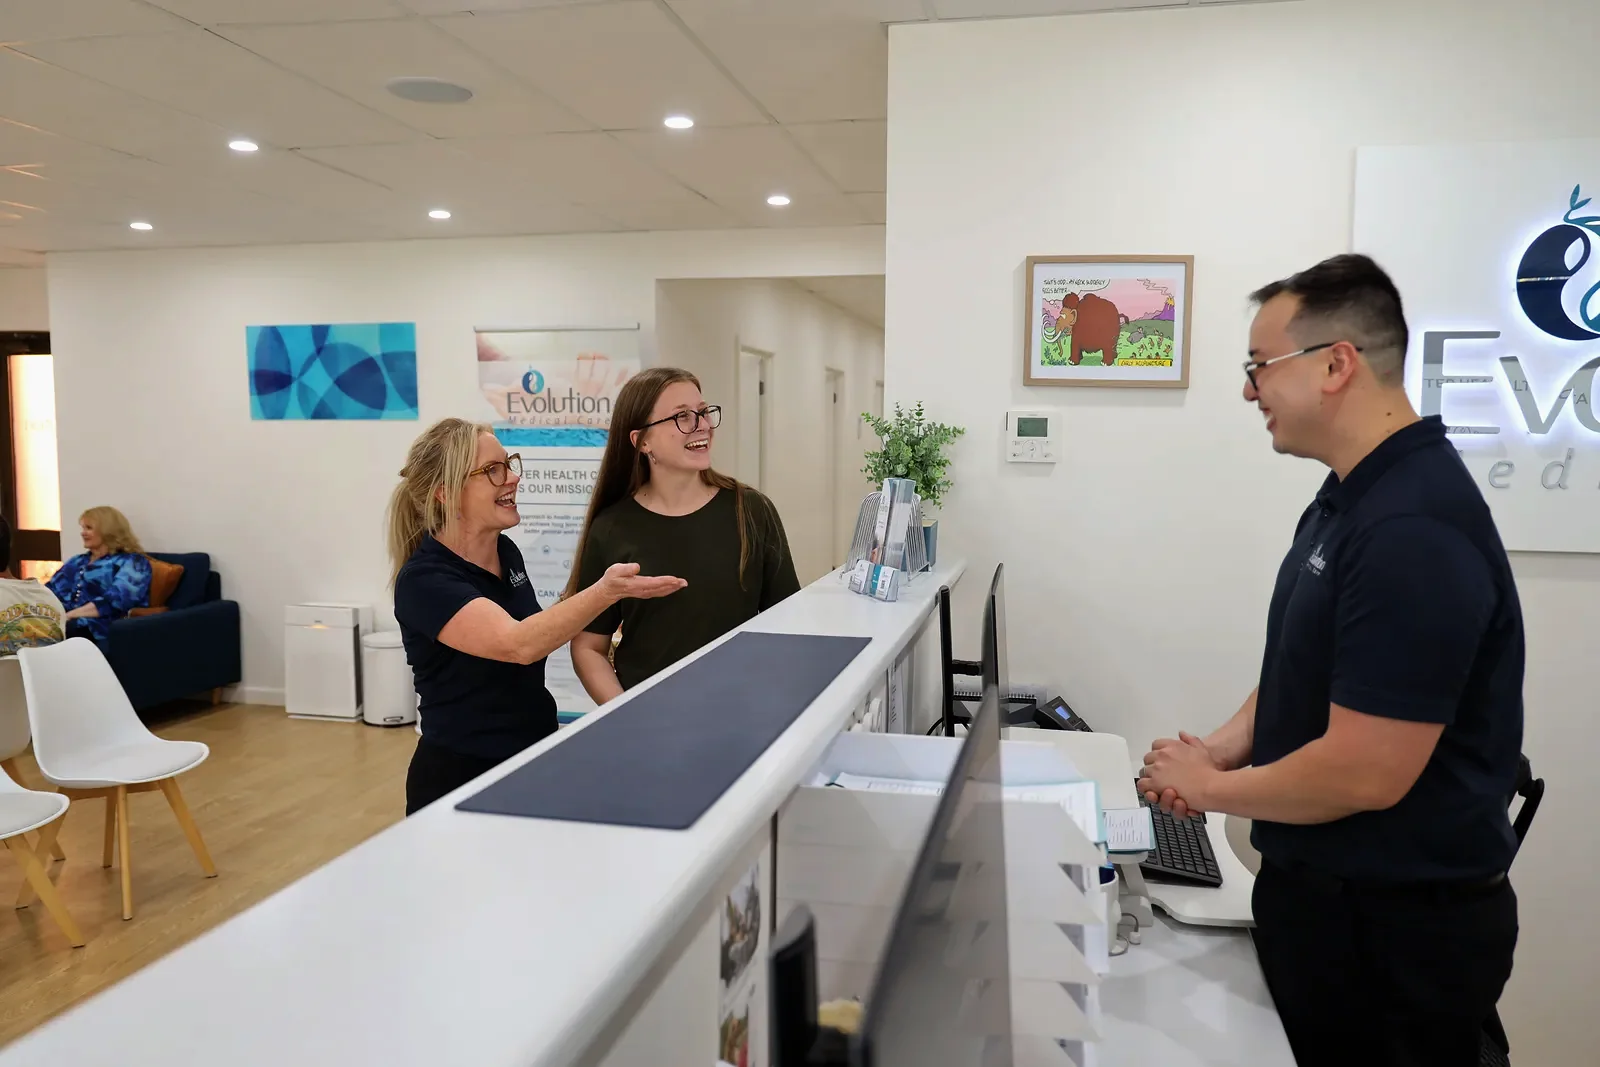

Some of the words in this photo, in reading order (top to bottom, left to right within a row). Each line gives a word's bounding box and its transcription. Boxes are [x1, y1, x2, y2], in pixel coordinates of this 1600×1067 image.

[507, 387, 611, 414] Evolution
[508, 415, 568, 425] Medical
[576, 415, 612, 425] Care
[543, 470, 587, 480] HEALTH
[528, 483, 553, 494] OUR
